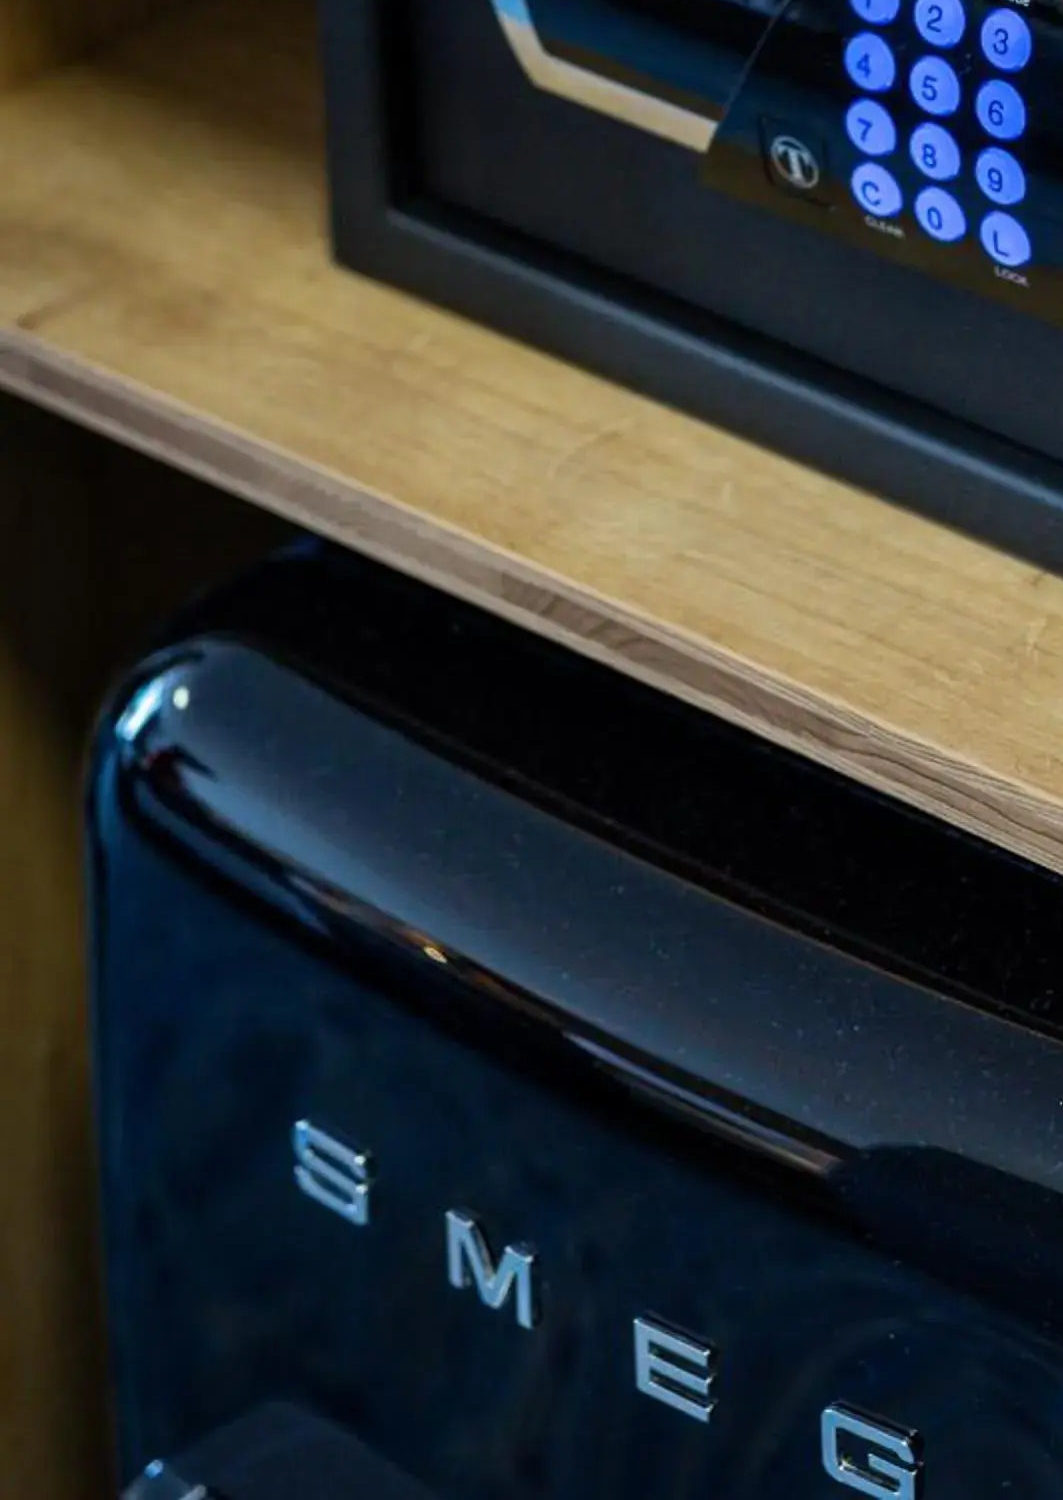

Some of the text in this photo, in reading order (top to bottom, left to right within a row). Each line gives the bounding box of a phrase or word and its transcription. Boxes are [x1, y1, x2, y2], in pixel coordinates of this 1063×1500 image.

[928, 6, 943, 32] 2
[994, 29, 1009, 55] 3
[857, 54, 1003, 125] 4 5 6
[858, 118, 1002, 192] 7 8 9
[862, 182, 879, 205] C
[994, 232, 1009, 257] L
[994, 266, 1030, 287] LOCK
